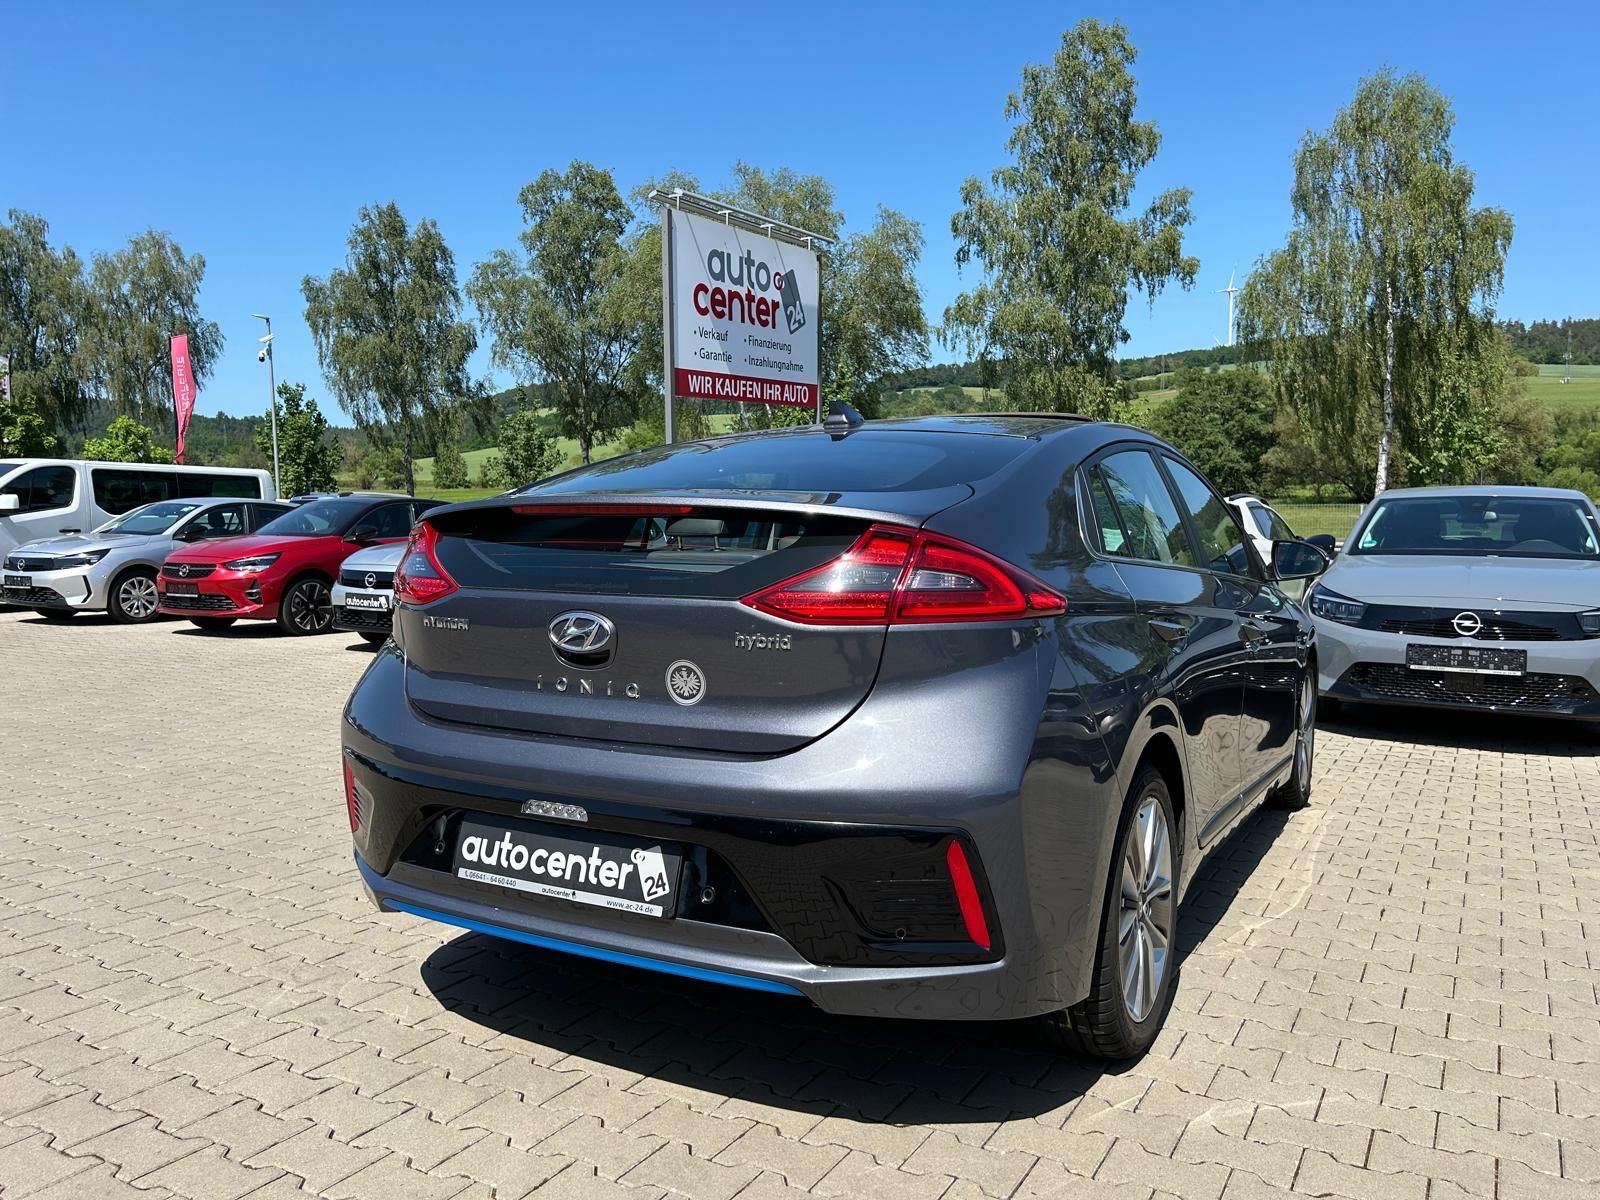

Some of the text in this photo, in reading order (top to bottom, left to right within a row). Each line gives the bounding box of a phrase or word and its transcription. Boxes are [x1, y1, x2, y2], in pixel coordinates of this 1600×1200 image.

[707, 249, 771, 292] auto
[693, 283, 780, 329] center
[786, 302, 805, 329] 24
[698, 327, 729, 342] Verkauf
[748, 335, 792, 354] Finanzierung
[699, 348, 733, 363] Garantie
[748, 355, 804, 373] Inzahlungnahme
[688, 374, 809, 403] WIR KAUFEN IHR AUTO
[346, 596, 380, 608] autocenter
[734, 632, 793, 651] hybrid
[461, 831, 634, 890] autocenter
[643, 871, 667, 897] 24
[606, 899, 654, 914] www.ac-24.de
